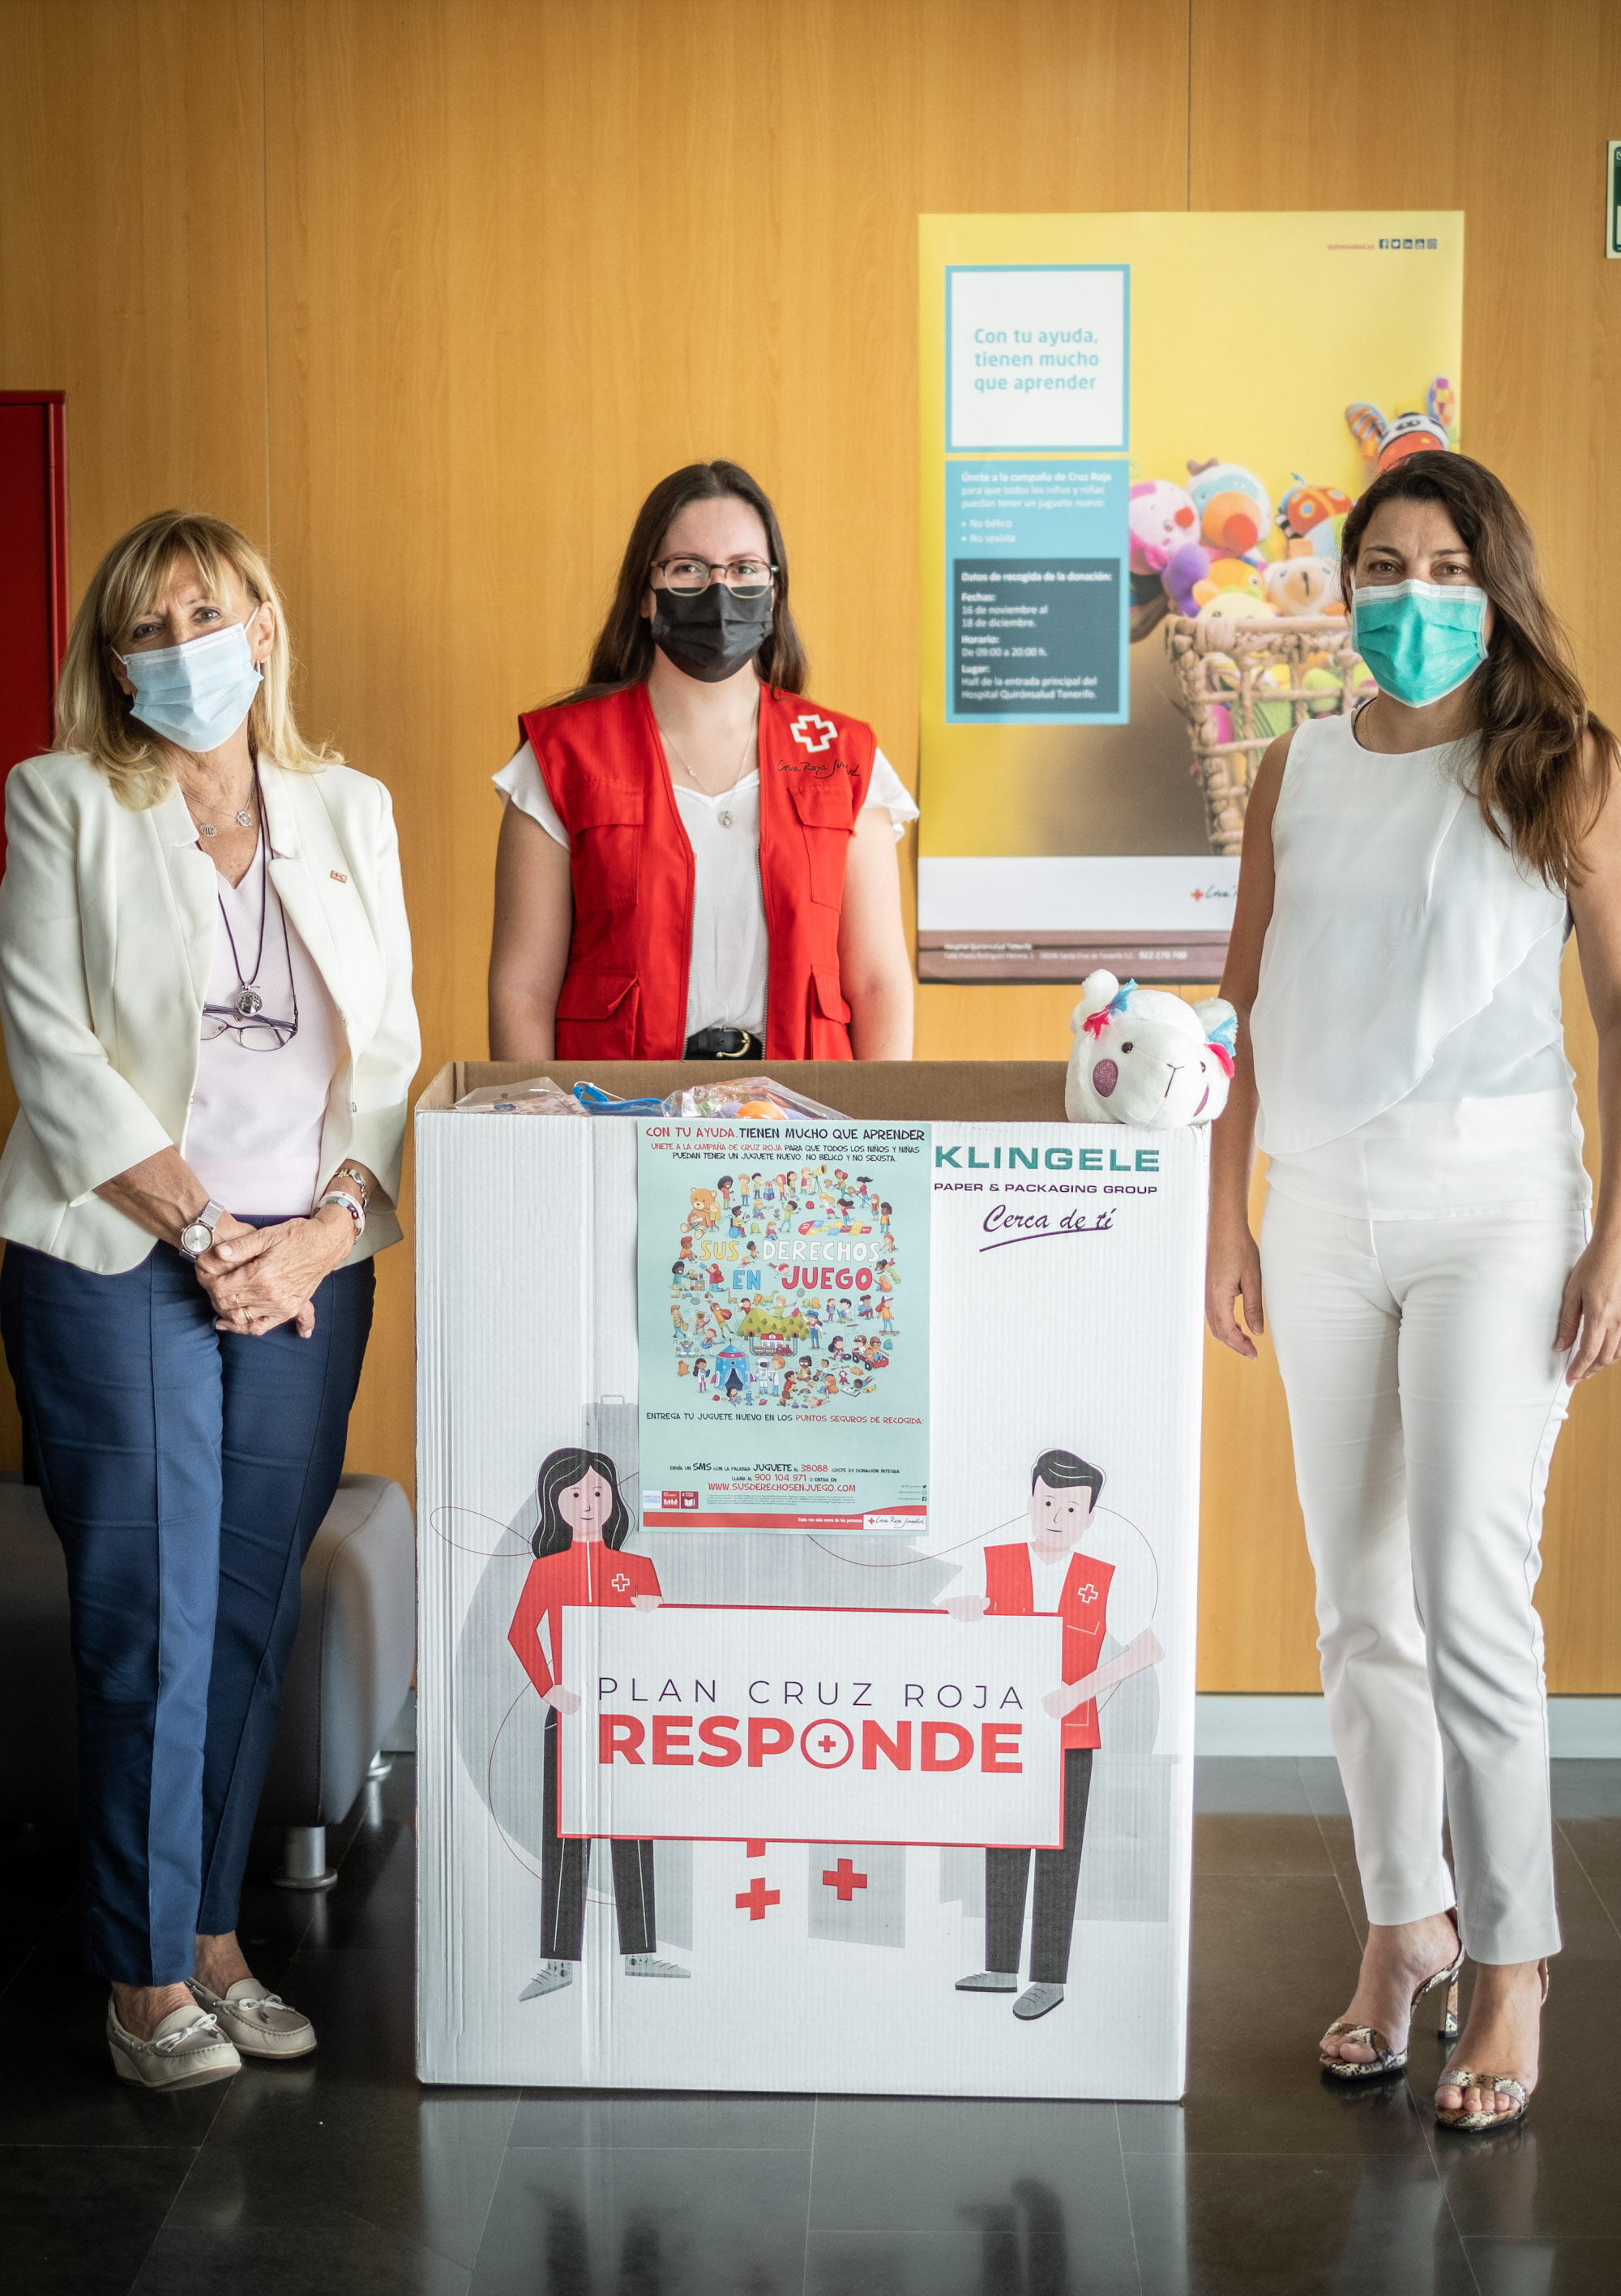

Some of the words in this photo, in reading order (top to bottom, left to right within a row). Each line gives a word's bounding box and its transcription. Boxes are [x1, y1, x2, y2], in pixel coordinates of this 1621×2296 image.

[974, 328, 1007, 344] Con
[1013, 329, 1033, 344] tu
[1037, 328, 1098, 347] ayuda,
[974, 351, 1033, 366] tienen
[1039, 351, 1099, 366] mucho
[974, 377, 1007, 394] que
[1013, 374, 1097, 393] aprender
[1054, 472, 1066, 482] de
[1067, 472, 1089, 482] Cruz
[1090, 472, 1112, 483] Roja
[969, 520, 983, 528] No
[990, 572, 1001, 581] de
[1043, 572, 1055, 581] de
[1056, 572, 1066, 580] la
[961, 593, 996, 602] Fechas:
[975, 606, 986, 614] de
[988, 606, 1037, 614] noviembre
[975, 619, 986, 628] de
[961, 648, 974, 656] De
[961, 665, 990, 675] Lugar:
[981, 677, 992, 686] de
[1004, 677, 1040, 685] entrada
[1041, 677, 1080, 688] principal
[1082, 677, 1097, 685] del
[961, 690, 998, 700] Hospital
[801, 762, 828, 775] Roja
[646, 1127, 670, 1137] CON
[675, 1127, 691, 1137] TU
[696, 1127, 738, 1138] AYUDA,
[739, 1128, 780, 1138] TIENEN
[785, 1128, 828, 1139] MUCHO
[832, 1129, 858, 1140] QUE
[863, 1129, 926, 1141] APRENDER
[651, 1141, 674, 1150] ÚNETE
[694, 1142, 726, 1150] CAMPAÑA
[851, 1145, 865, 1153] LOS
[867, 1145, 889, 1153] NIÑOS
[899, 1145, 920, 1153] NIÑAS
[935, 1146, 1160, 1172] KLINGELE
[934, 1183, 983, 1192] PAPER
[989, 1184, 999, 1192] &
[1004, 1184, 1097, 1193] PACKAGING
[1103, 1185, 1157, 1194] GROUP
[982, 1204, 1050, 1232] Cerca
[1059, 1208, 1086, 1230] de
[1095, 1207, 1117, 1230] tí
[699, 1240, 739, 1261] SUS
[763, 1239, 881, 1262] DERECHOS
[733, 1270, 761, 1290] EN
[781, 1266, 873, 1291] JUEGO
[693, 1463, 712, 1471] SMS
[753, 1463, 792, 1471] JUGUETE
[801, 1464, 828, 1472] 38088
[755, 1473, 771, 1481] 900
[793, 1474, 806, 1482] 971
[708, 1482, 856, 1493] WWW.SUSDERECHOSENJUEGO.COM
[598, 1677, 717, 1703] PLAN
[748, 1680, 873, 1706] CRUZ
[905, 1683, 1024, 1710] ROJA
[598, 1713, 1024, 1774] RESPONDE
